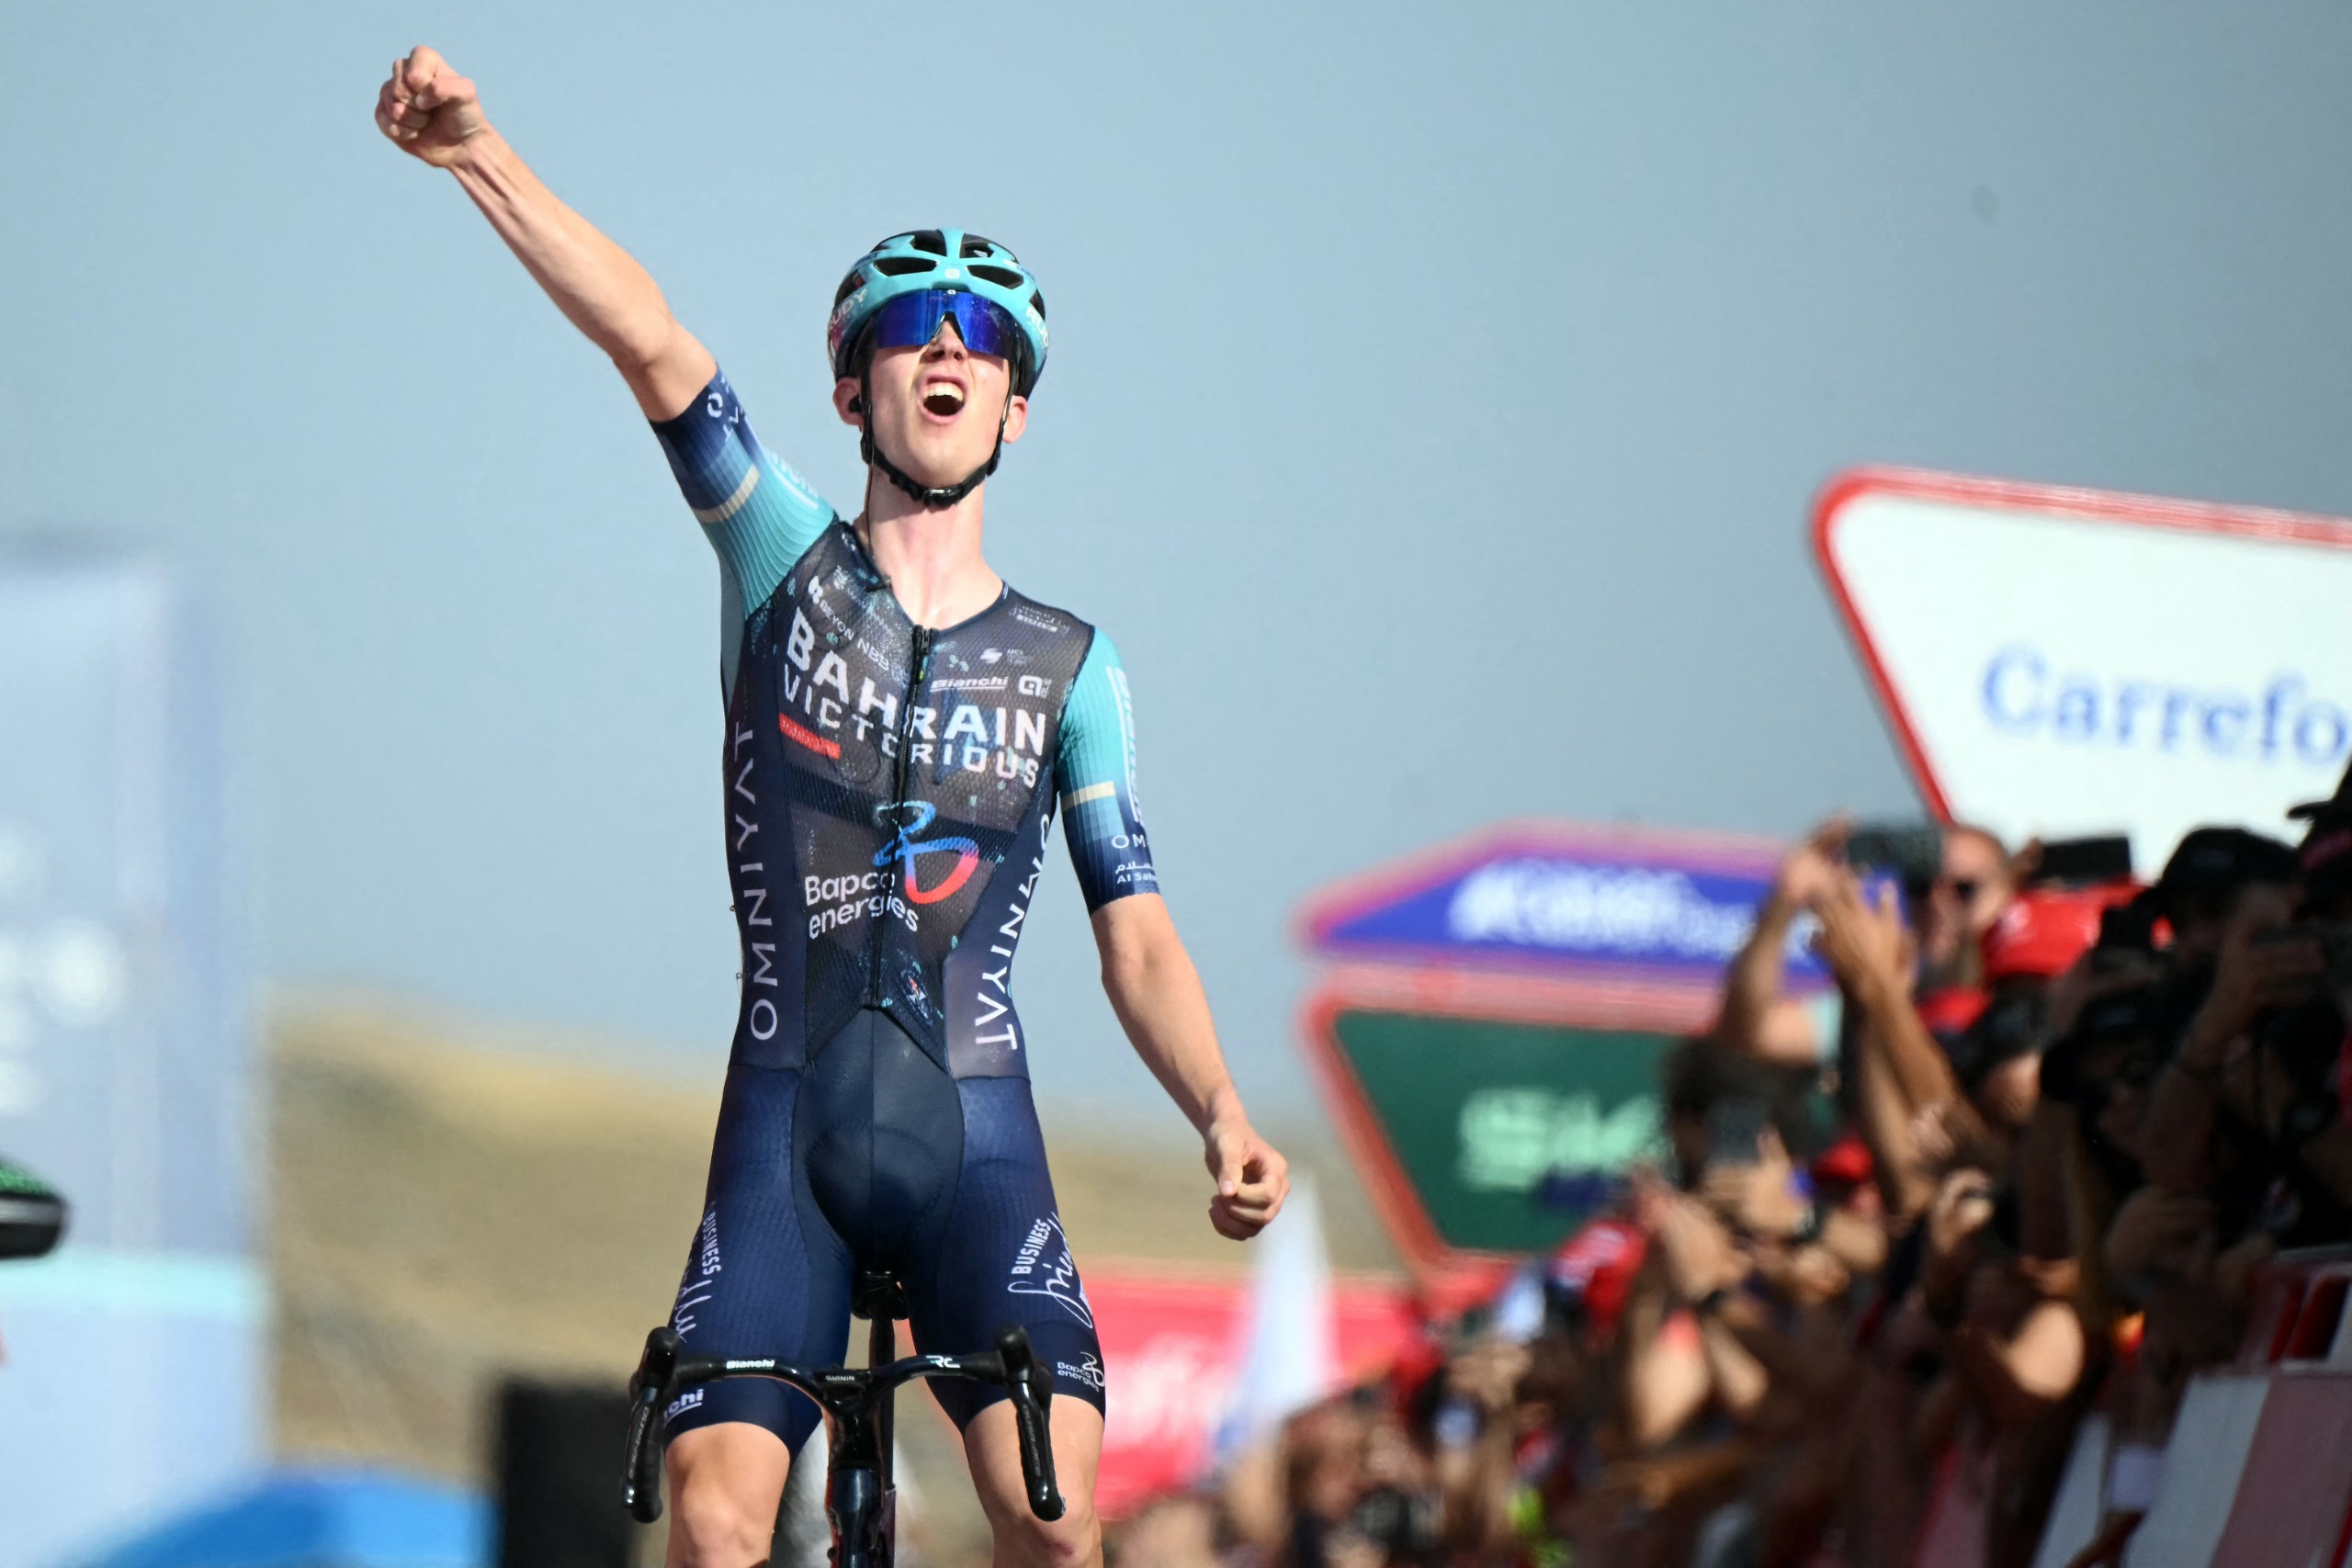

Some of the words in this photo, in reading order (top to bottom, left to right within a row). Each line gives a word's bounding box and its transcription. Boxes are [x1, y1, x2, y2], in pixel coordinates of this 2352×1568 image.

[856, 637, 889, 671] NBB
[786, 606, 1046, 757] BAHRAIN
[930, 676, 1009, 692] Bianchi
[1980, 640, 2347, 766] Carrefo
[784, 663, 1040, 789] VICTORIOUS
[734, 721, 779, 1042] OMNIYAT
[808, 889, 919, 940] energies
[702, 1212, 722, 1276] BUSINESS
[1011, 1218, 1052, 1275] BUSINESS
[726, 1359, 775, 1370] Bianchi
[1057, 1361, 1091, 1379] Bapco
[1057, 1370, 1100, 1393] energies
